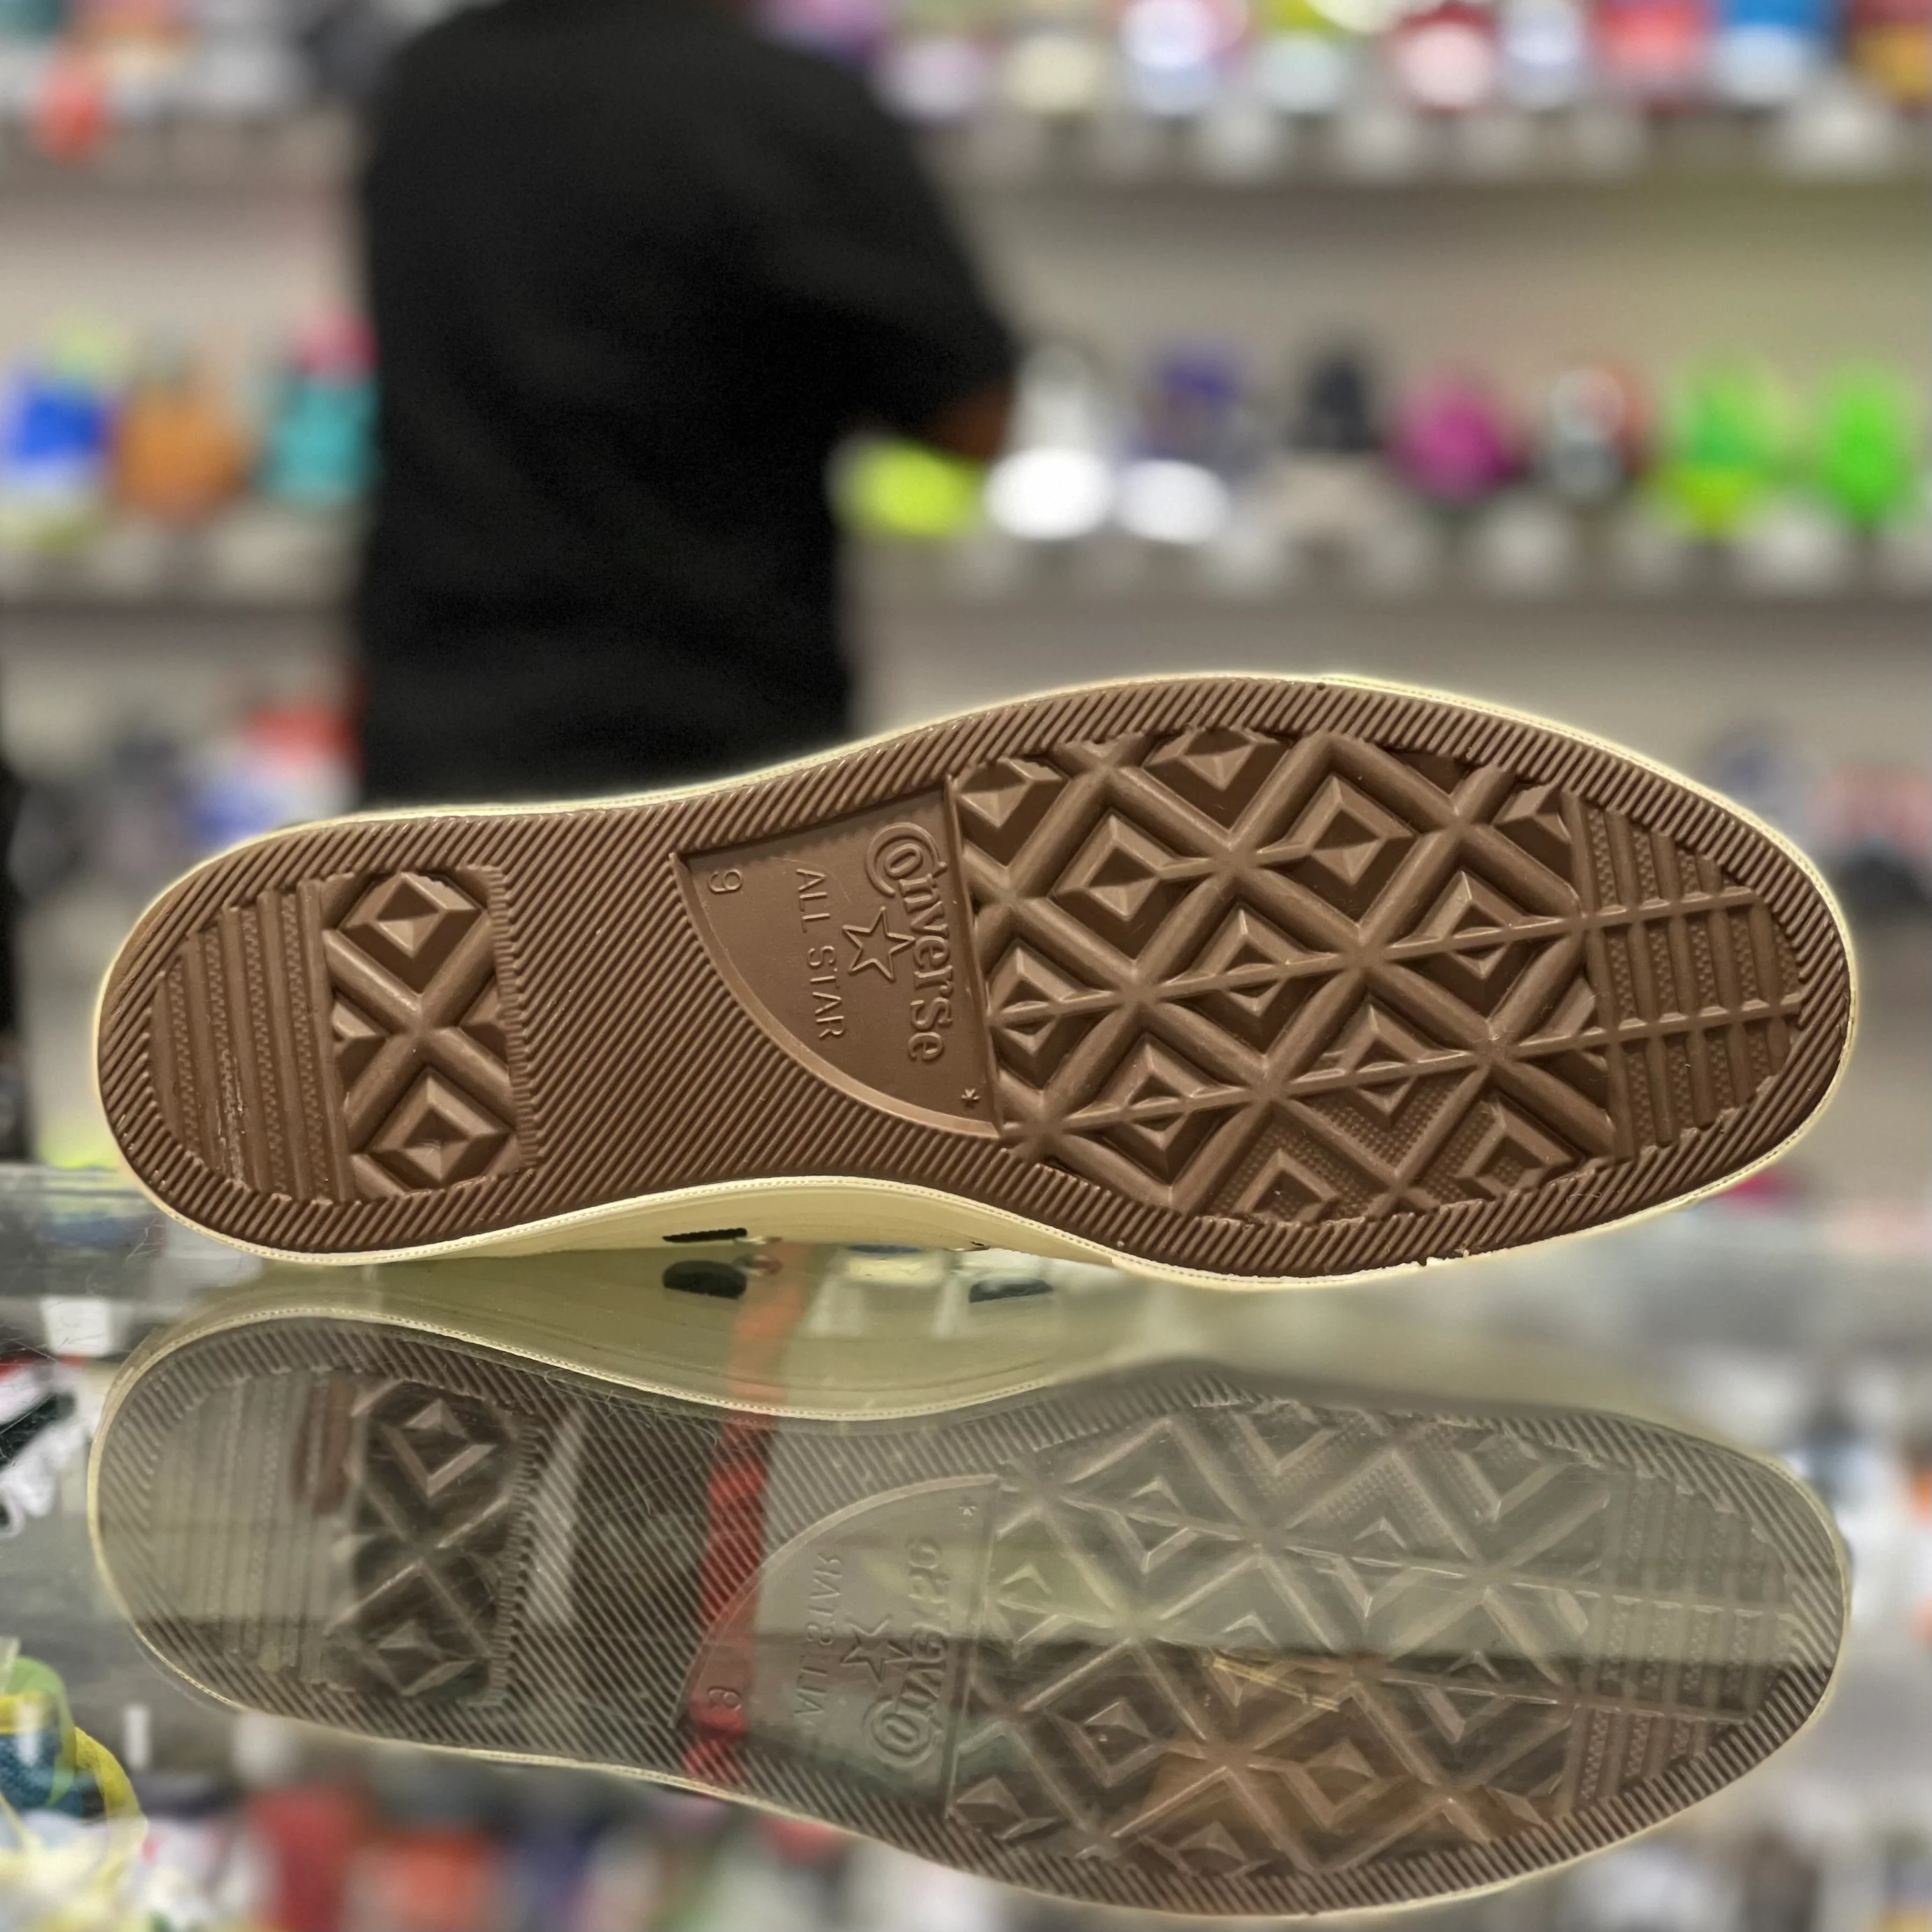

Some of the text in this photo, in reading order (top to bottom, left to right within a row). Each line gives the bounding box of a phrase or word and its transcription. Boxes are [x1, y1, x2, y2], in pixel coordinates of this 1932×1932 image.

[710, 868, 743, 894] 9
[796, 868, 845, 1040] ALL STAR
[866, 822, 954, 1062] Converse
